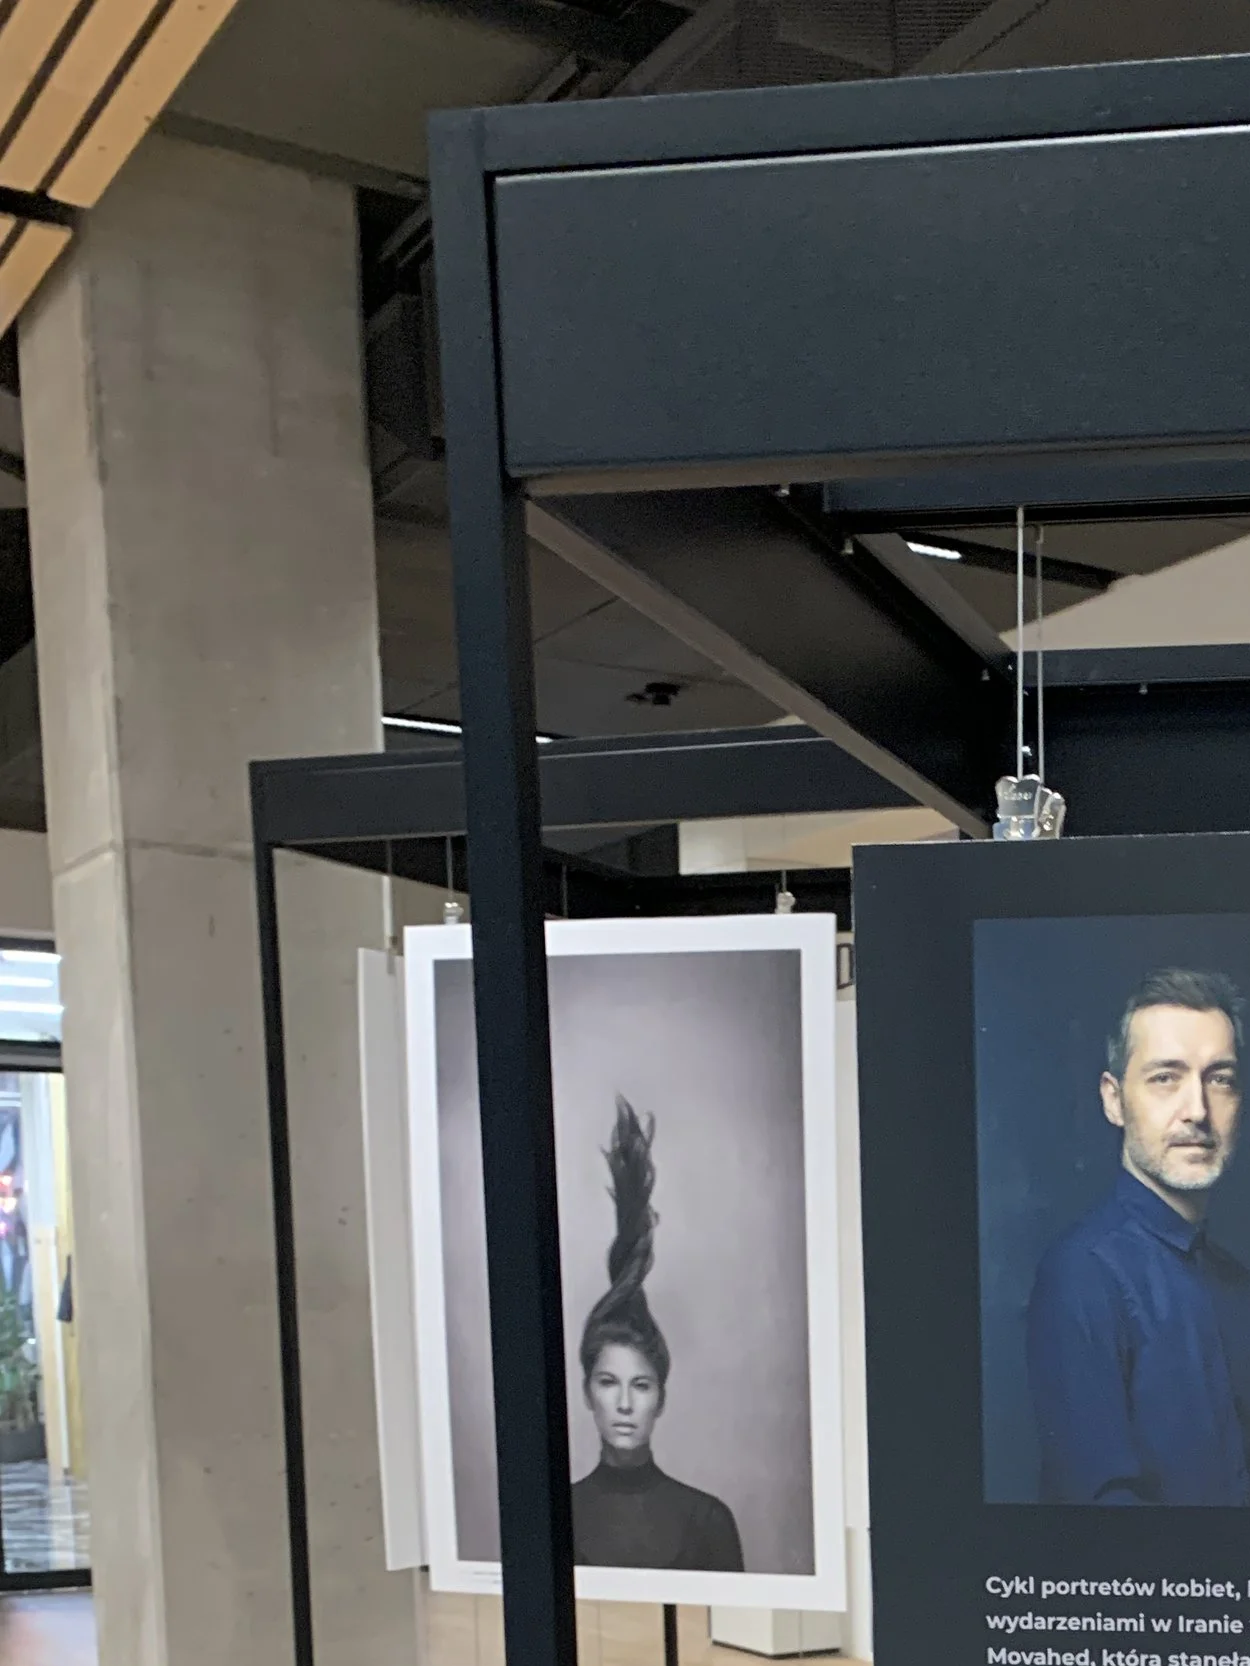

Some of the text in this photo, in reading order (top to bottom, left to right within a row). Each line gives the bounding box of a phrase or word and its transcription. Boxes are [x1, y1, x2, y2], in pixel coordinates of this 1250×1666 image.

[985, 1575, 1035, 1599] Cykl
[1041, 1576, 1156, 1600] portretów
[1161, 1577, 1242, 1602] kobiet,
